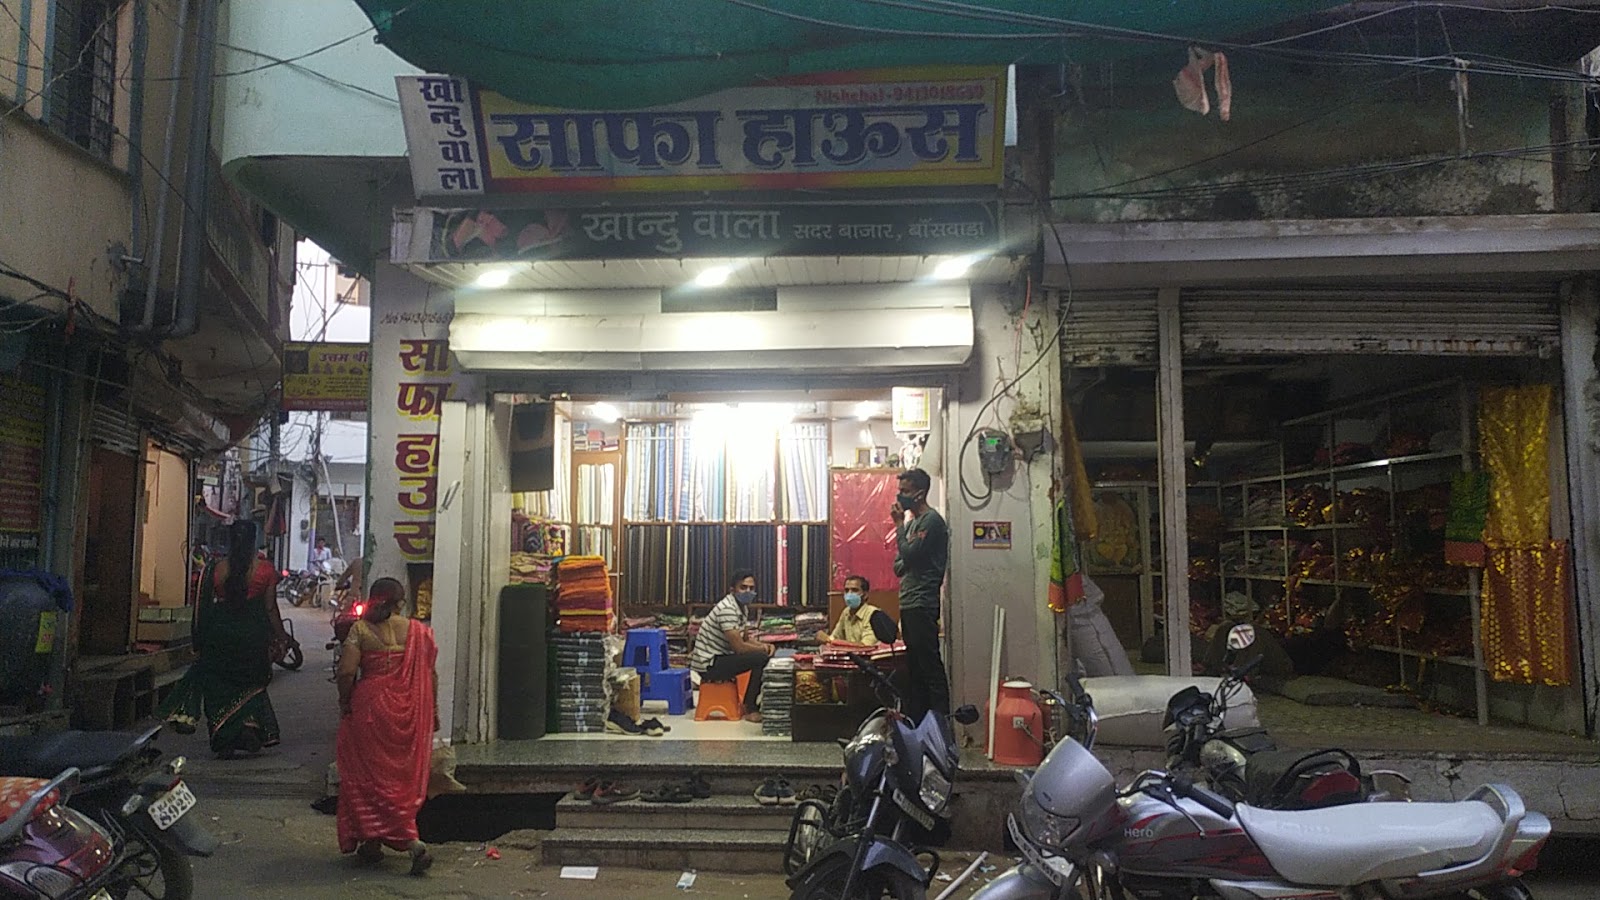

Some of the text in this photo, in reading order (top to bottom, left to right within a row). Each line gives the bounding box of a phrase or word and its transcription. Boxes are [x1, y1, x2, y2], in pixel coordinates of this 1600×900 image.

[489, 103, 988, 171] साफा हाऊस
[692, 209, 781, 240] वाला
[793, 223, 833, 240] सदर
[159, 792, 193, 826] 8929
